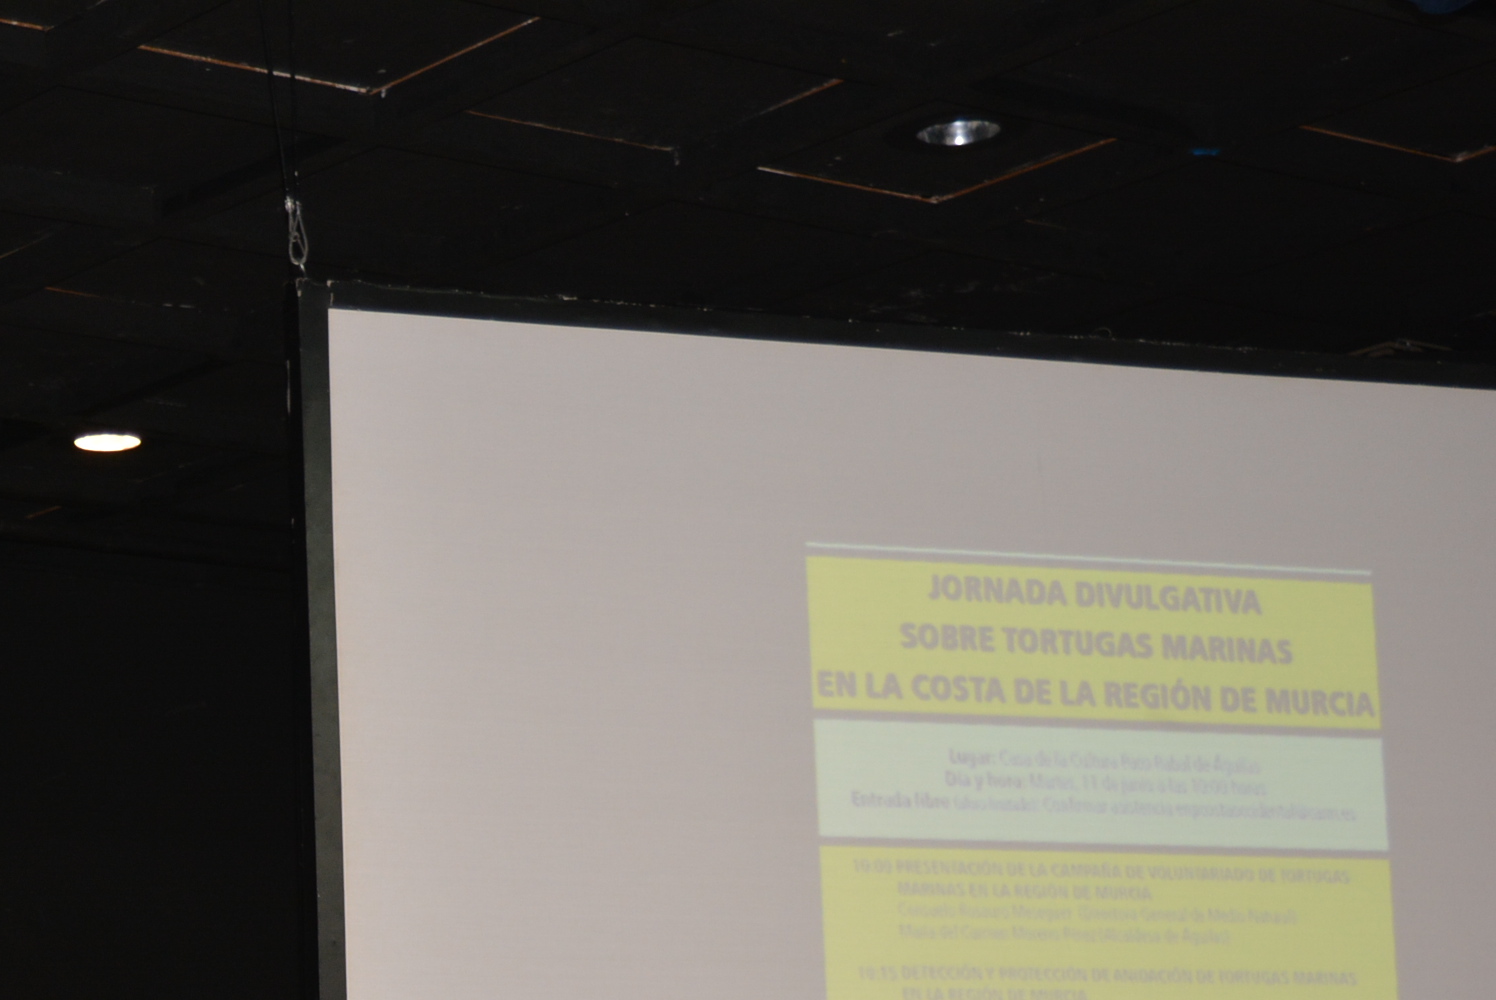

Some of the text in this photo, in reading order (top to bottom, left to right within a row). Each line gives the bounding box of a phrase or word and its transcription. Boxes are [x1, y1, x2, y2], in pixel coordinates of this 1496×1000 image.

[929, 574, 1262, 615] JORNADA DIVULGATIVA
[900, 622, 1293, 664] SOBRE TORTUGAS MARINAS
[817, 671, 1375, 717] EN LA COSTA DE LA REGIÓN DE MURCIA
